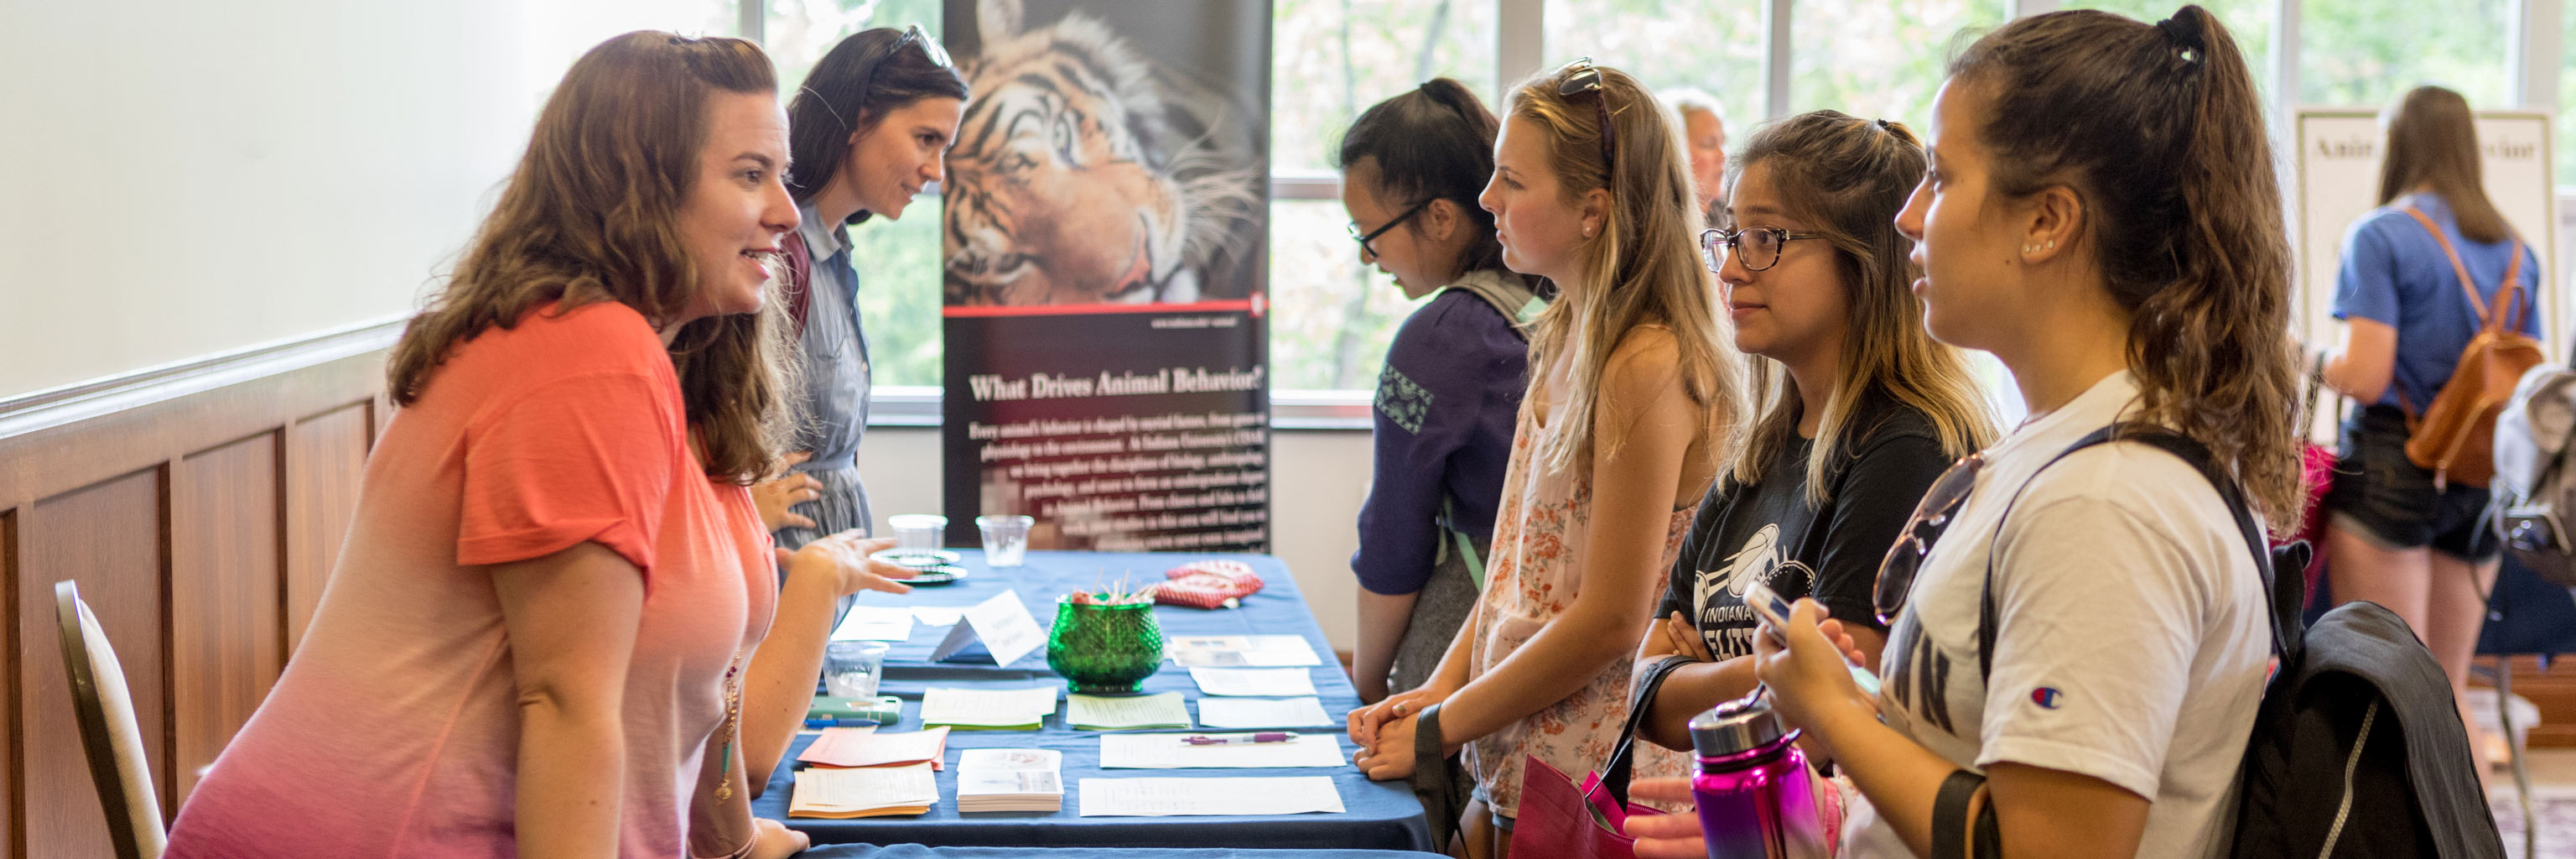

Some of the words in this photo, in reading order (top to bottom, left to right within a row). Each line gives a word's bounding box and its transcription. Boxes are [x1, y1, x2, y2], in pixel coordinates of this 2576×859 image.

[969, 374, 1027, 401] What
[1031, 372, 1093, 398] Drives
[1096, 369, 1169, 396] Animal
[1173, 365, 1264, 393] Behavior?
[969, 421, 999, 440] Every
[1705, 606, 1753, 623] INDIANA
